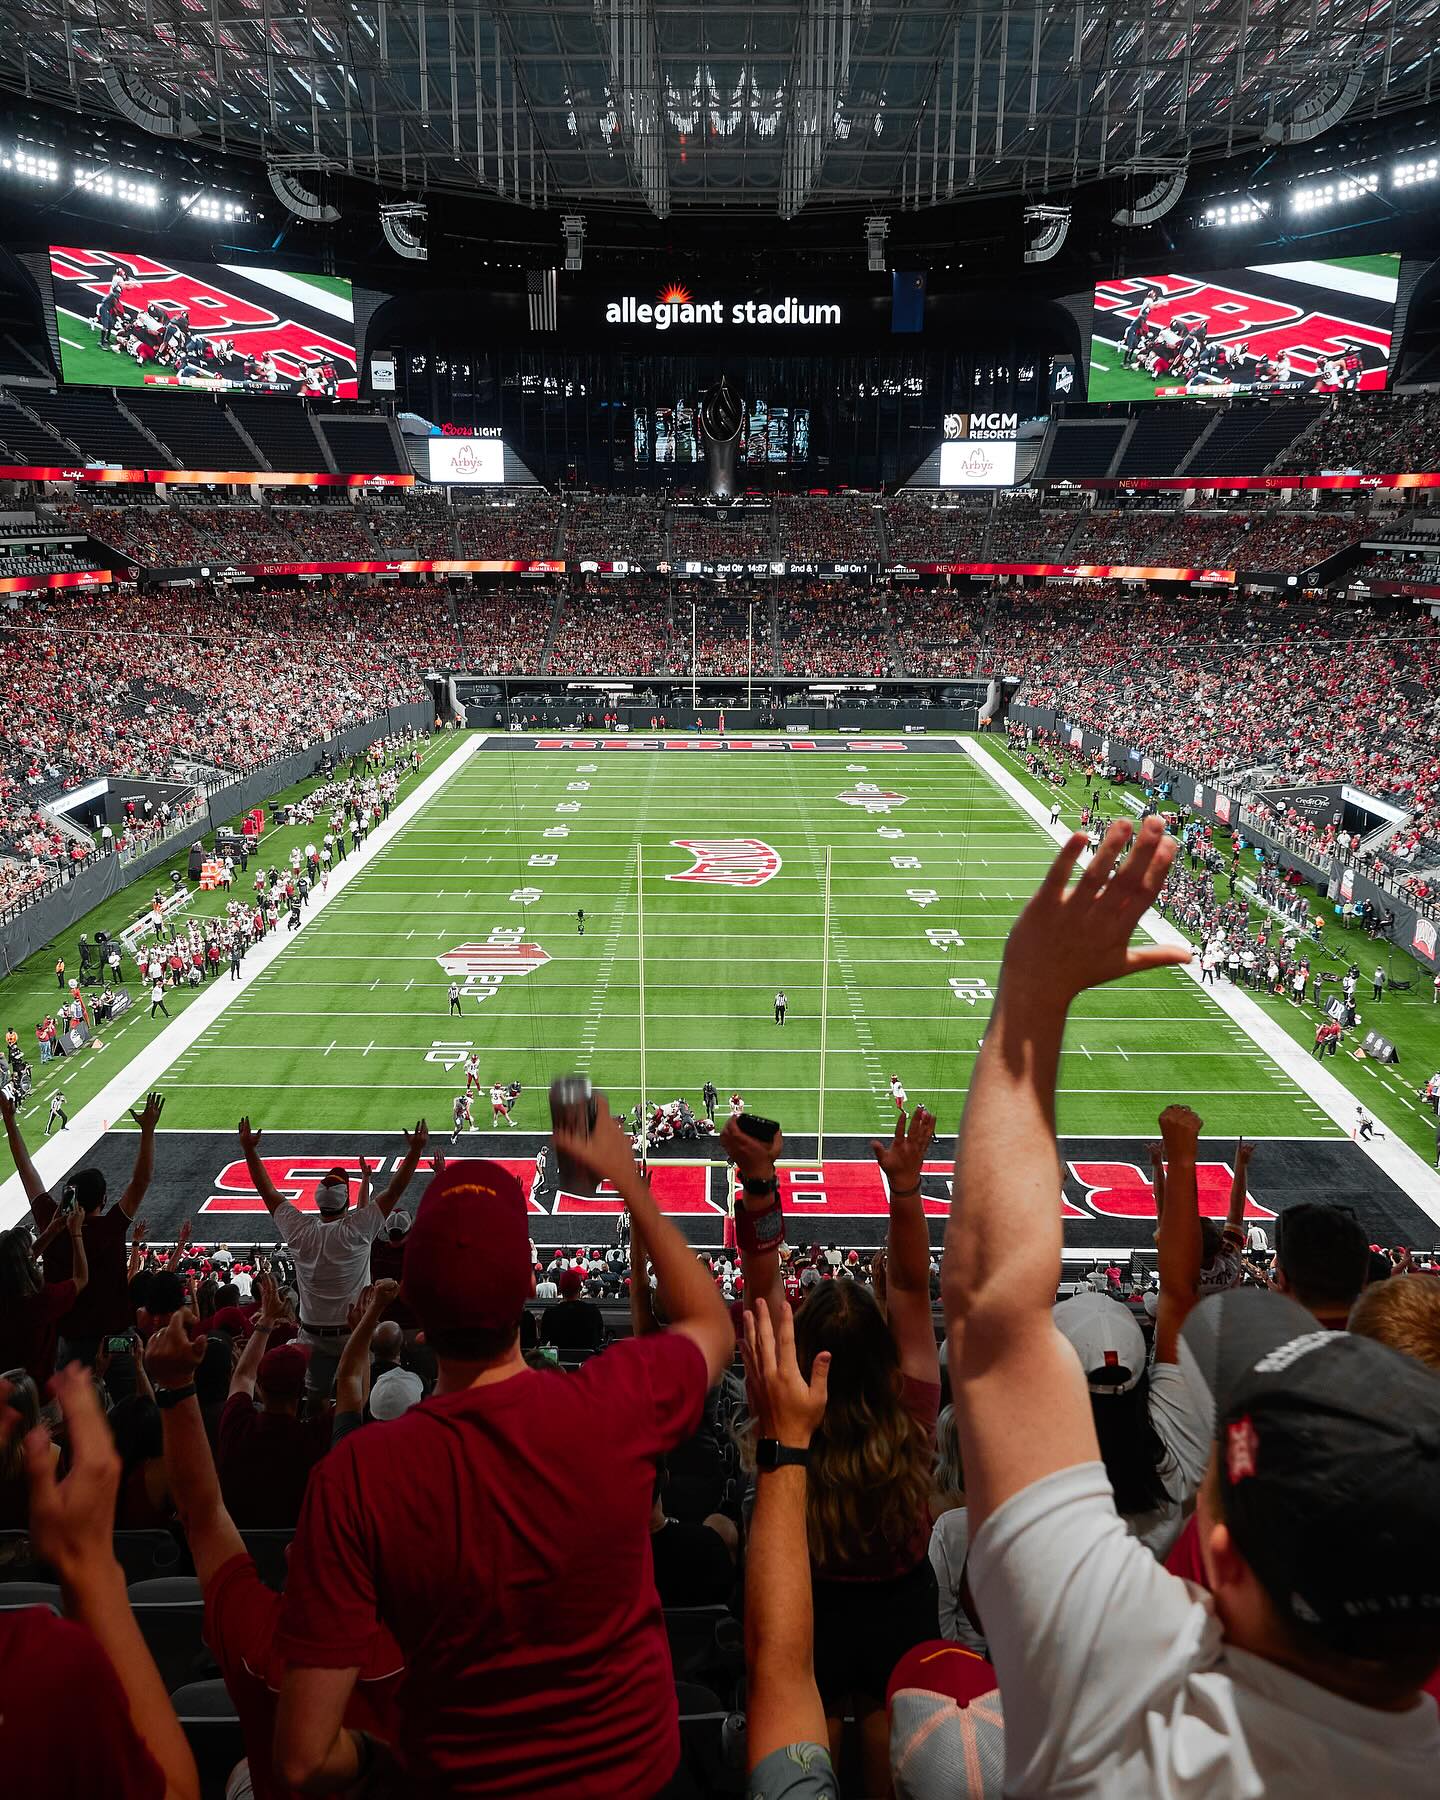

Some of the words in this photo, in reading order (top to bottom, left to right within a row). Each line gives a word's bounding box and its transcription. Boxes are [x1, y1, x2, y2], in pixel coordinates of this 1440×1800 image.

[606, 297, 723, 330] allegiant
[731, 297, 841, 324] stadium
[970, 413, 1017, 429] MGM
[442, 422, 473, 436] Coors
[474, 427, 502, 436] LIGHT
[970, 430, 1016, 439] RESORTS
[450, 457, 483, 469] Arby's
[961, 459, 993, 472] Arby's
[264, 566, 282, 574] NEW
[717, 564, 731, 572] 2nd
[732, 564, 743, 572] Qtr
[748, 564, 767, 572] 14:57
[790, 564, 805, 572] 2nd
[806, 564, 813, 572] &
[814, 564, 818, 572] 1
[835, 564, 848, 572] Ball
[850, 564, 861, 572] On
[863, 564, 867, 572] 1
[936, 565, 956, 573] NEW
[534, 739, 908, 751] REBELS
[424, 1041, 474, 1063] 10
